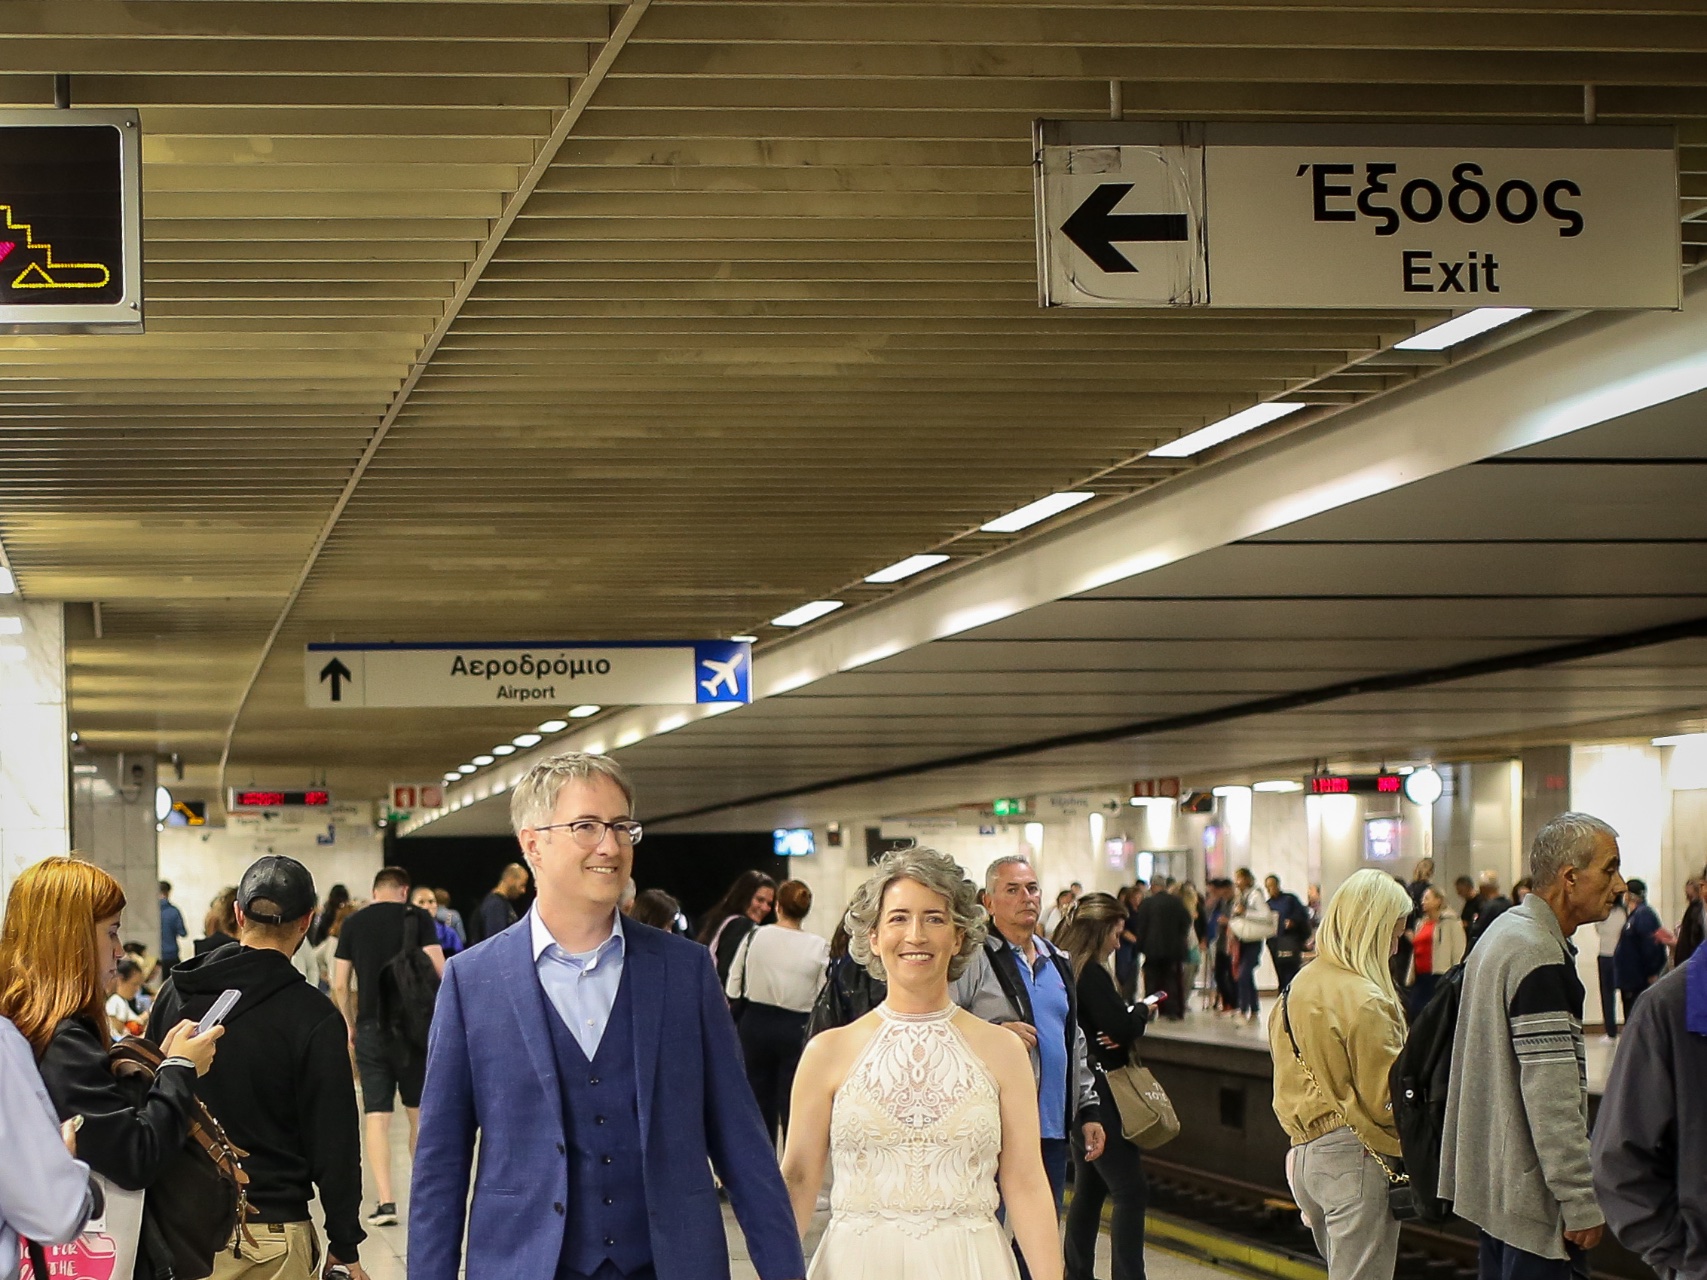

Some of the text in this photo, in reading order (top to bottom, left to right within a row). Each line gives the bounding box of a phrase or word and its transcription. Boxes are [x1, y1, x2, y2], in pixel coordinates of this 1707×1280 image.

[1296, 162, 1585, 238] Έξοδος
[1401, 251, 1500, 294] Exit
[450, 653, 612, 680] Αεροδρόμιο
[496, 685, 556, 702] Airport
[47, 1260, 79, 1277] THE
